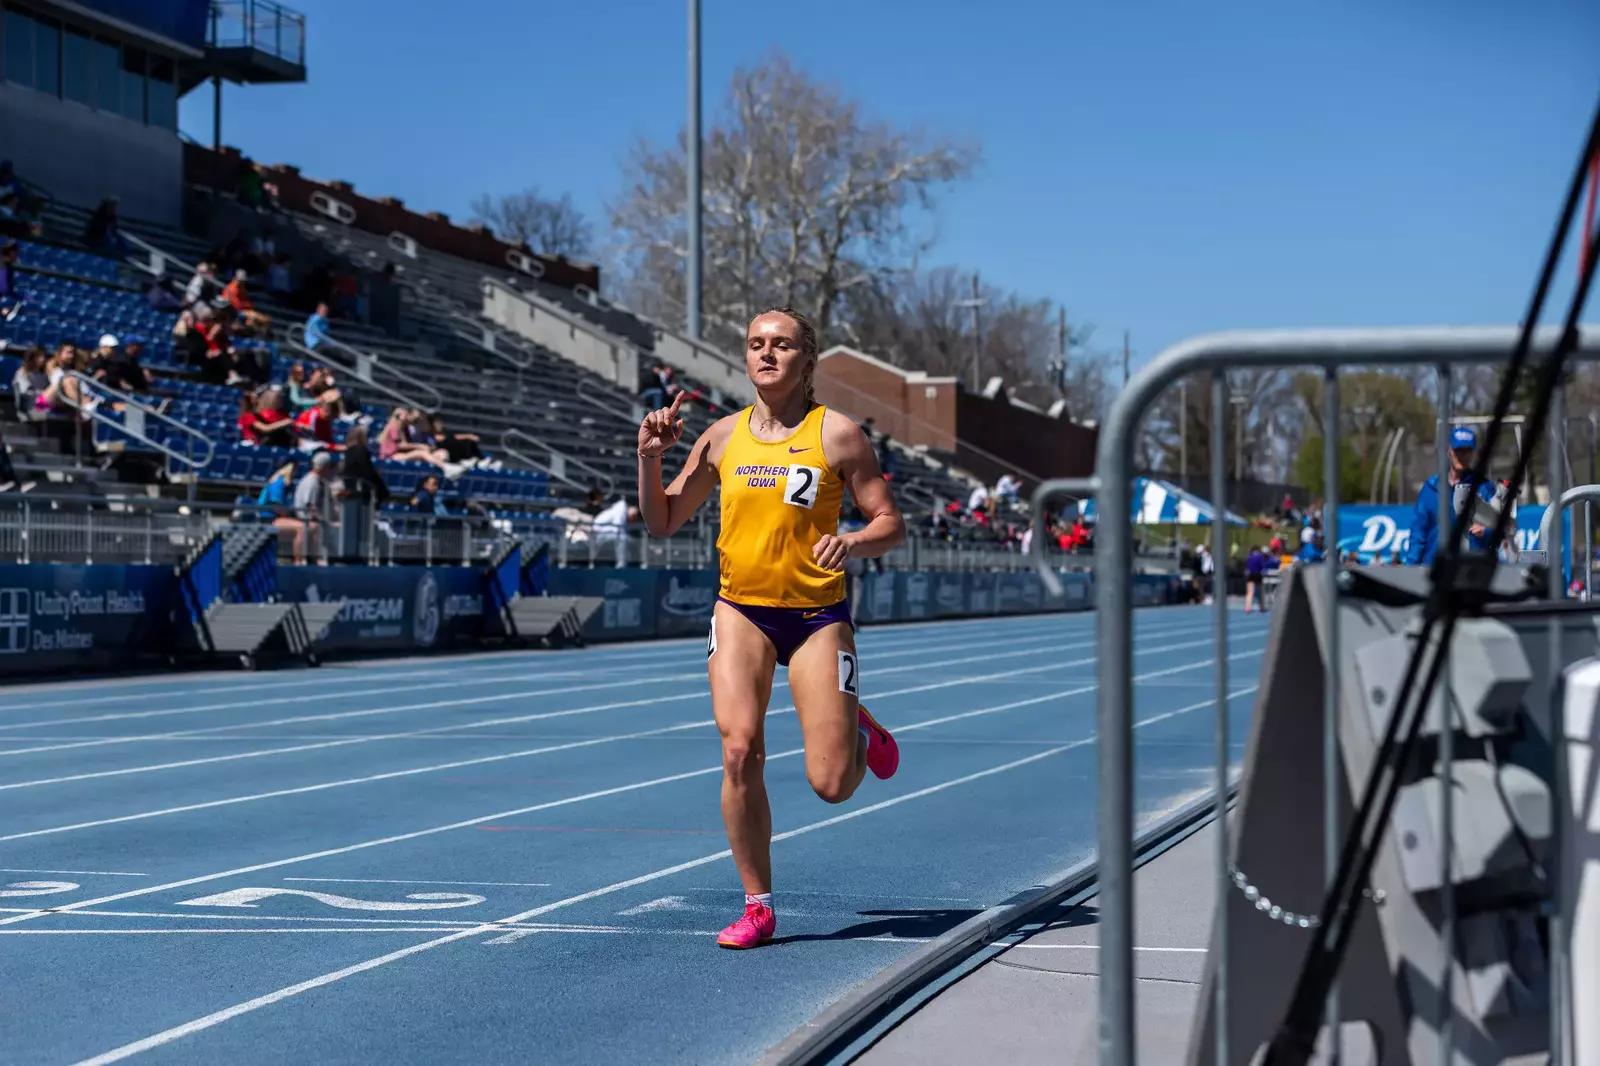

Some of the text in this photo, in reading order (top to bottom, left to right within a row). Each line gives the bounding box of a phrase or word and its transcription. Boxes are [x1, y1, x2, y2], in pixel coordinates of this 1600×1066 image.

[747, 477, 777, 488] IOWA
[790, 468, 813, 506] 2
[843, 654, 856, 693] 2
[175, 887, 487, 911] 2
